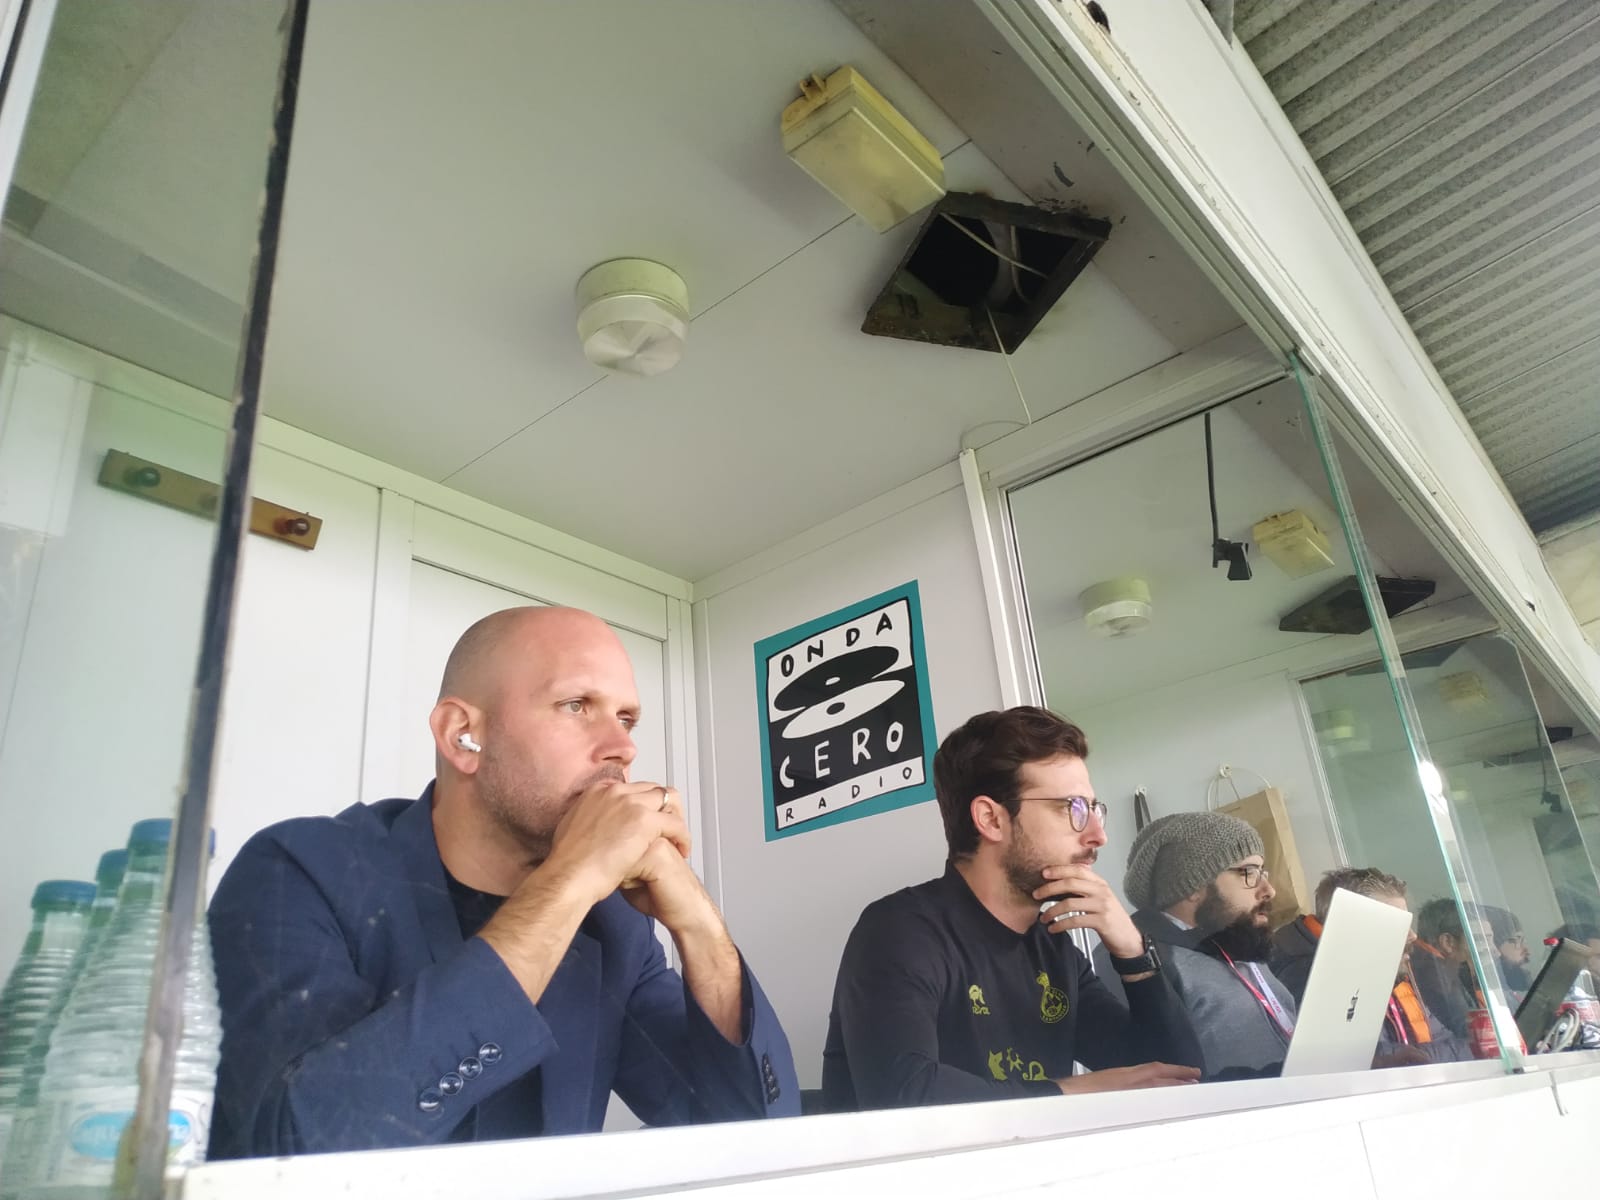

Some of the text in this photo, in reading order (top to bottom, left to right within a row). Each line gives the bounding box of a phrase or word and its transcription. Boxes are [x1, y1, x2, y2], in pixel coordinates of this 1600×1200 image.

[781, 612, 892, 677] ONDA
[779, 721, 904, 789] CERO
[785, 766, 912, 822] RADIO
